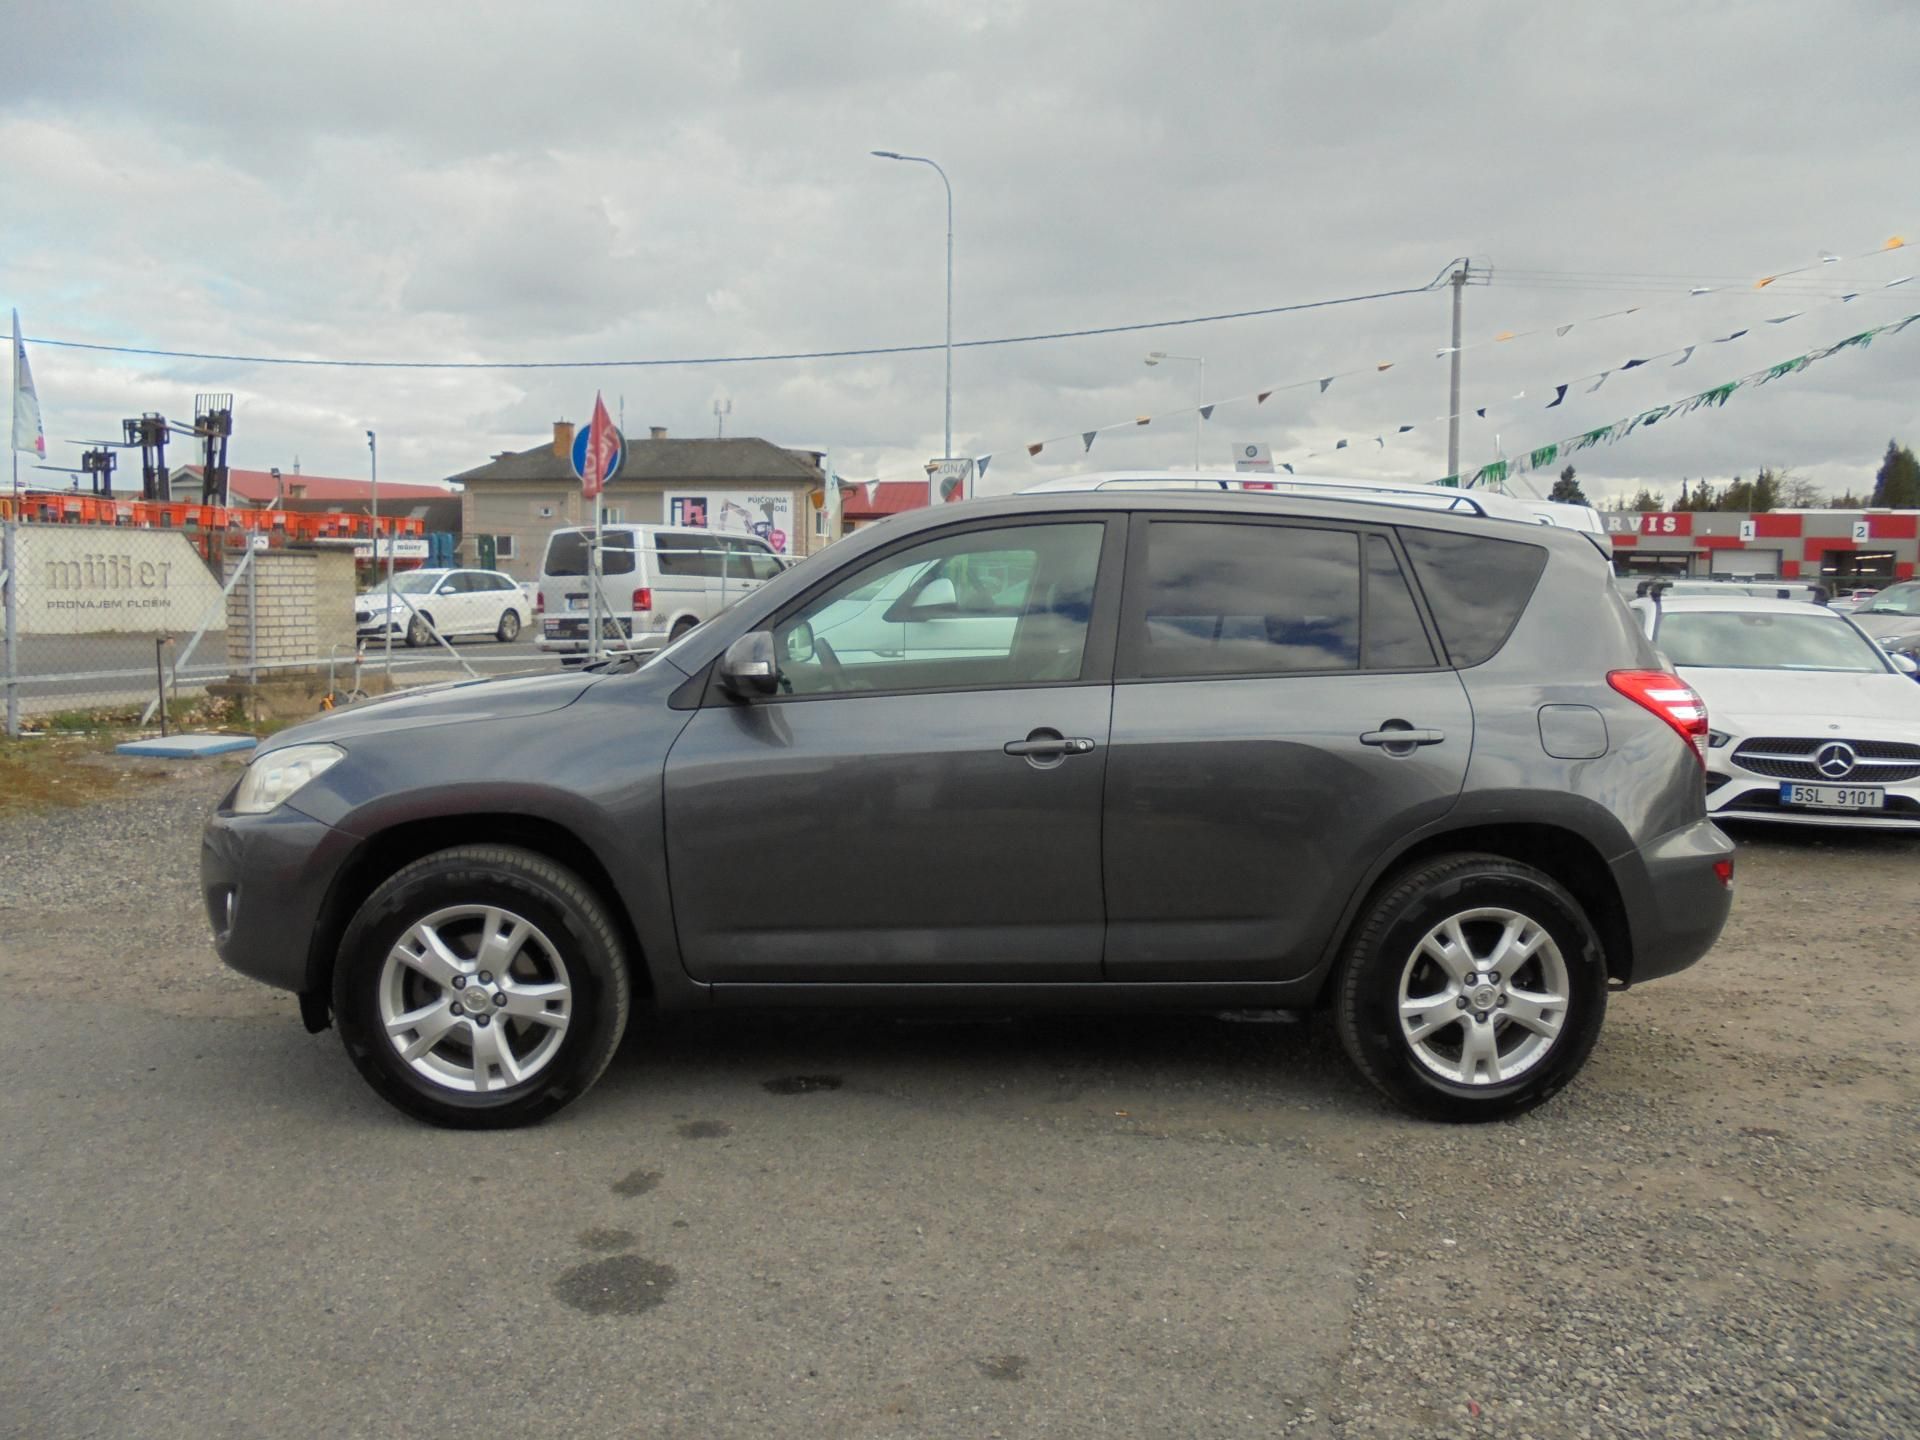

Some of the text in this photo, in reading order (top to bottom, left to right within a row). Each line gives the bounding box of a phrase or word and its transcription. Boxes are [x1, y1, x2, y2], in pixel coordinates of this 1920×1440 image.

[937, 463, 968, 474] ZONA
[1608, 516, 1677, 533] RVIS
[1743, 526, 1752, 537] 1
[1856, 526, 1865, 538] 2
[45, 553, 172, 590] müller
[1794, 787, 1876, 806] 5SL 9101
